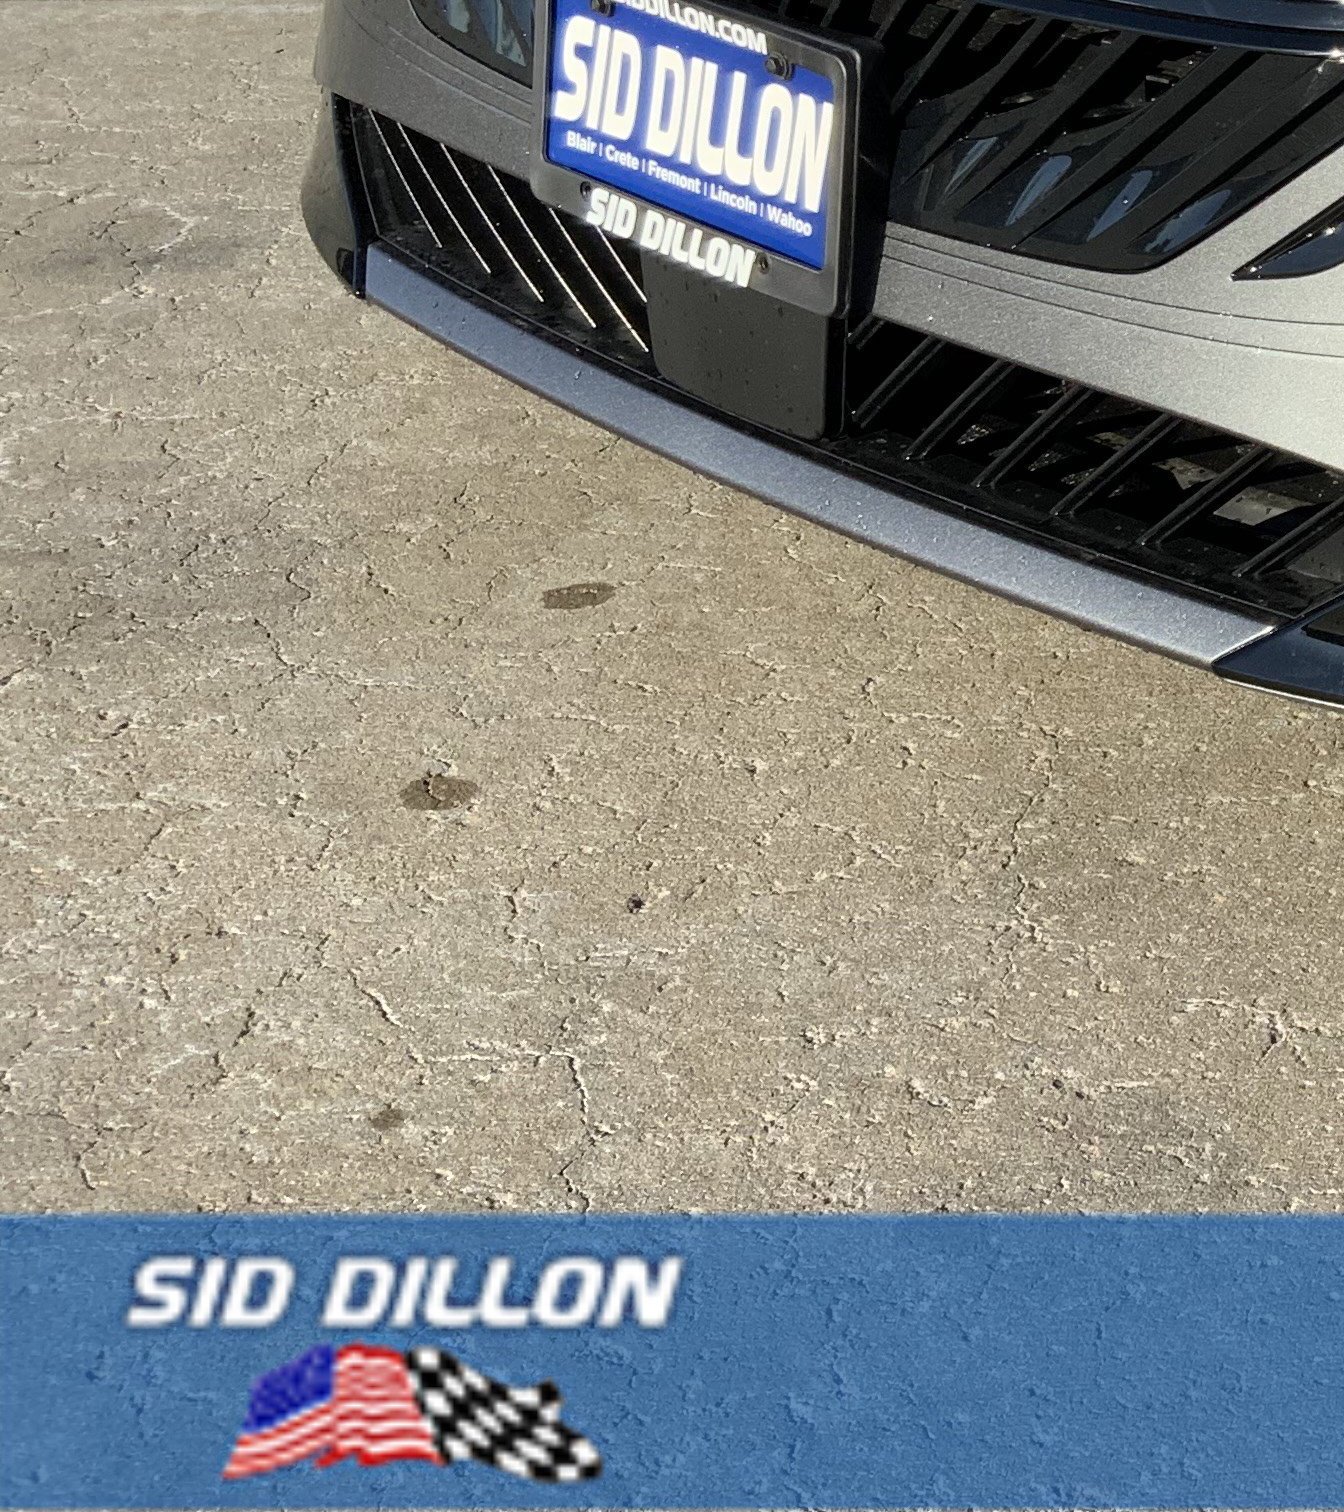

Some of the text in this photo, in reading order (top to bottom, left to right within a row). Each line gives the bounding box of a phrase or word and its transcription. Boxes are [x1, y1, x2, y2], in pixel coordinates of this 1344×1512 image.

[554, 14, 835, 214] SID DILLON
[566, 130, 814, 237] Blair Crete Fremont Lincoln Wahoo
[586, 187, 757, 289] SID DILLON
